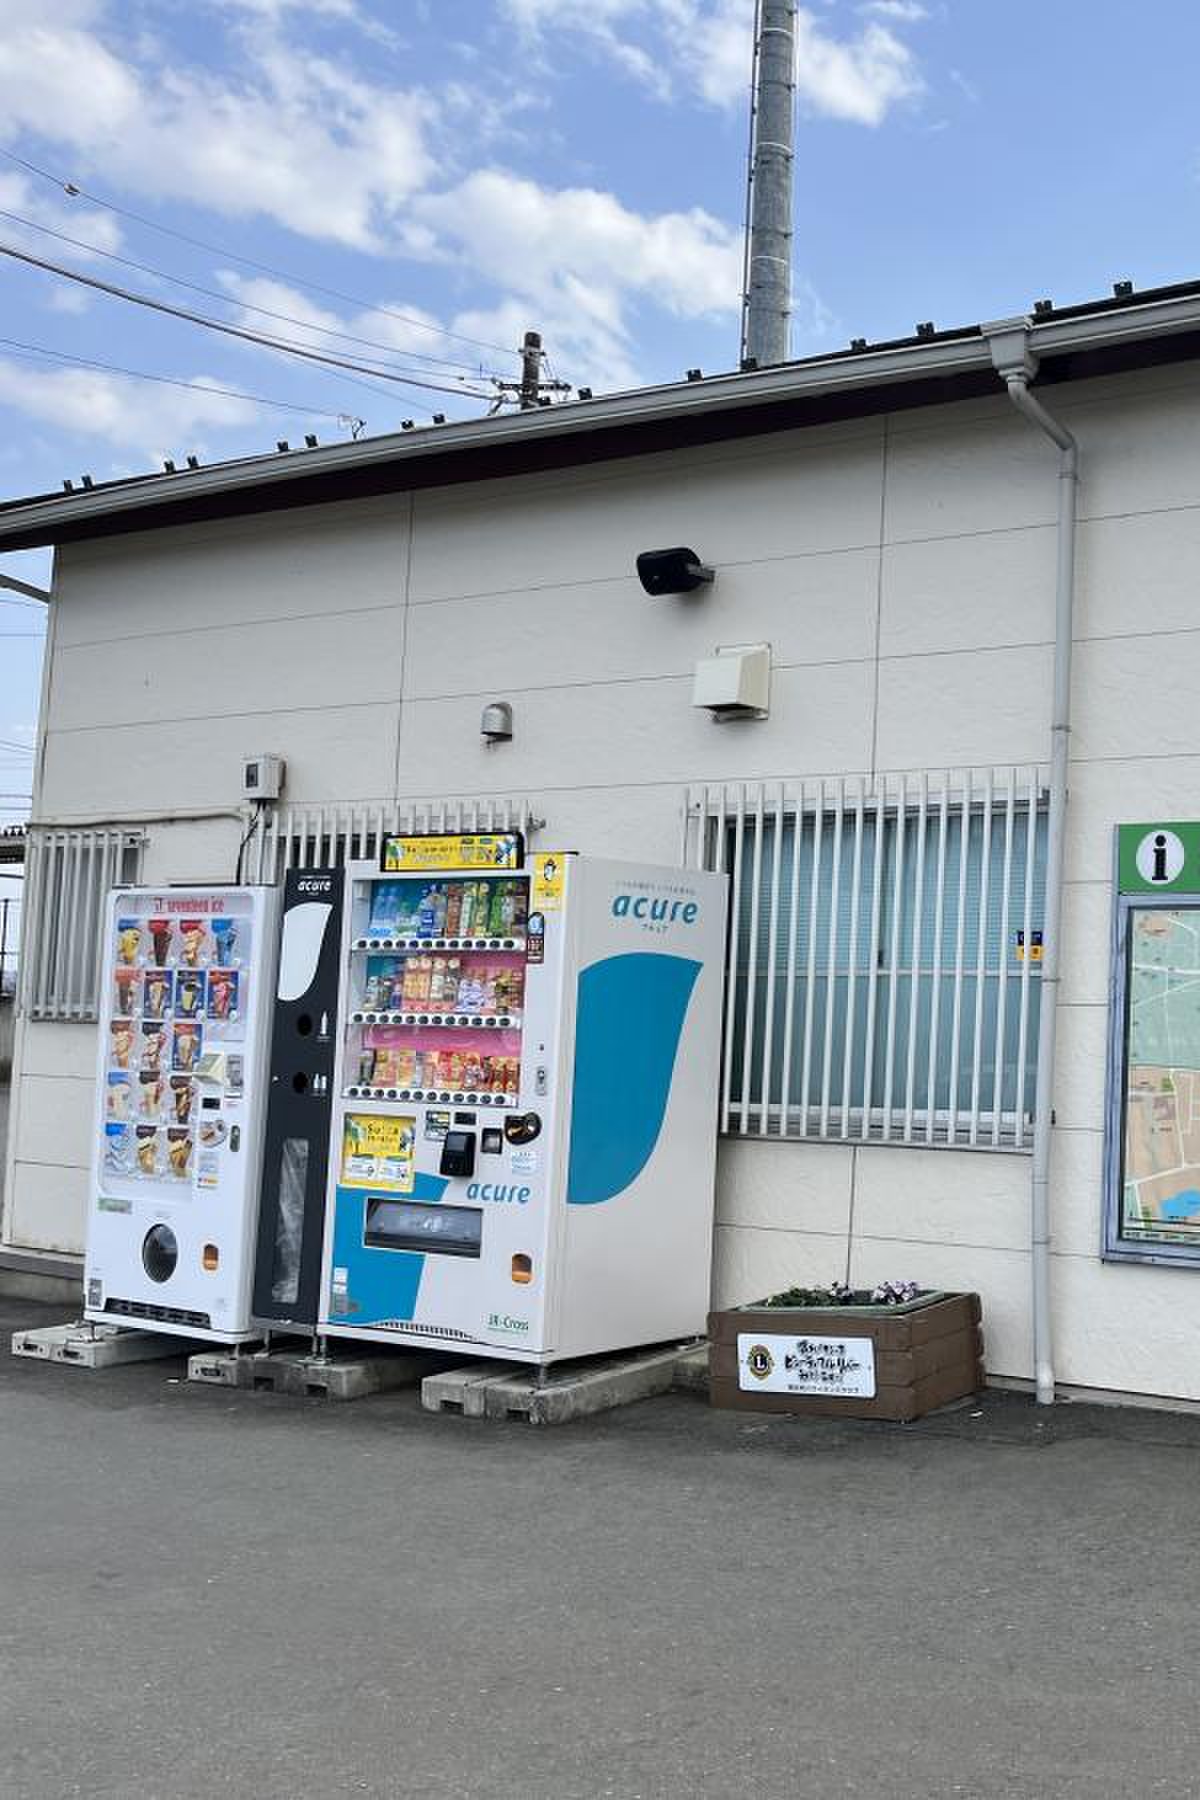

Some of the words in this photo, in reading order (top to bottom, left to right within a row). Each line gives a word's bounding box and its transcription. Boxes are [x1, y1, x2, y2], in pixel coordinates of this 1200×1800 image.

[297, 879, 332, 891] acure
[612, 894, 699, 925] acure
[466, 1182, 531, 1204] acure
